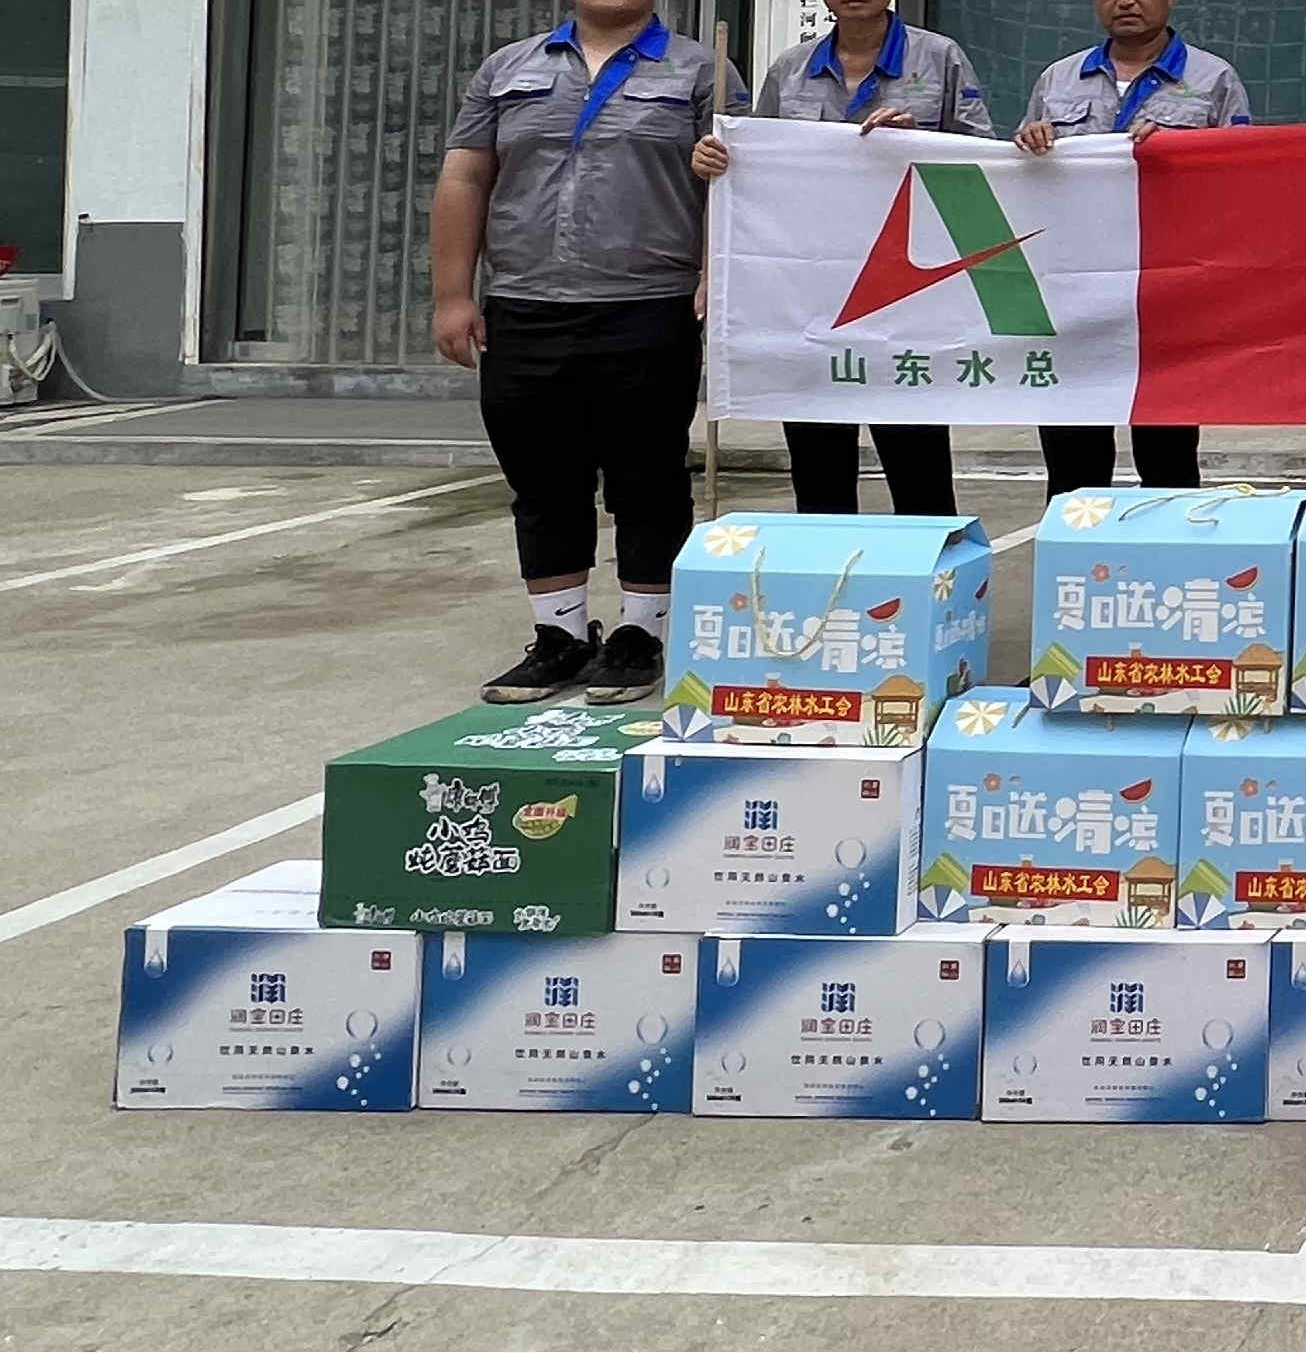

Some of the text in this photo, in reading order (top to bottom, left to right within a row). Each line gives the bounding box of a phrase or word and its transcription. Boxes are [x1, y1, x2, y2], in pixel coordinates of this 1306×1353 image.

[830, 350, 1059, 387] 山东水总
[1052, 575, 1267, 643] 夏日送清凉
[690, 604, 907, 673] 夏日送清凉
[1096, 658, 1222, 688] 山东省农林水工会
[724, 691, 852, 719] 山东省农林水工会
[427, 814, 492, 845] 小鸡
[945, 783, 1160, 854] 夏日送清凉
[405, 843, 520, 877] 炖蘑菇面
[981, 868, 1111, 897] 山东省农林水工会
